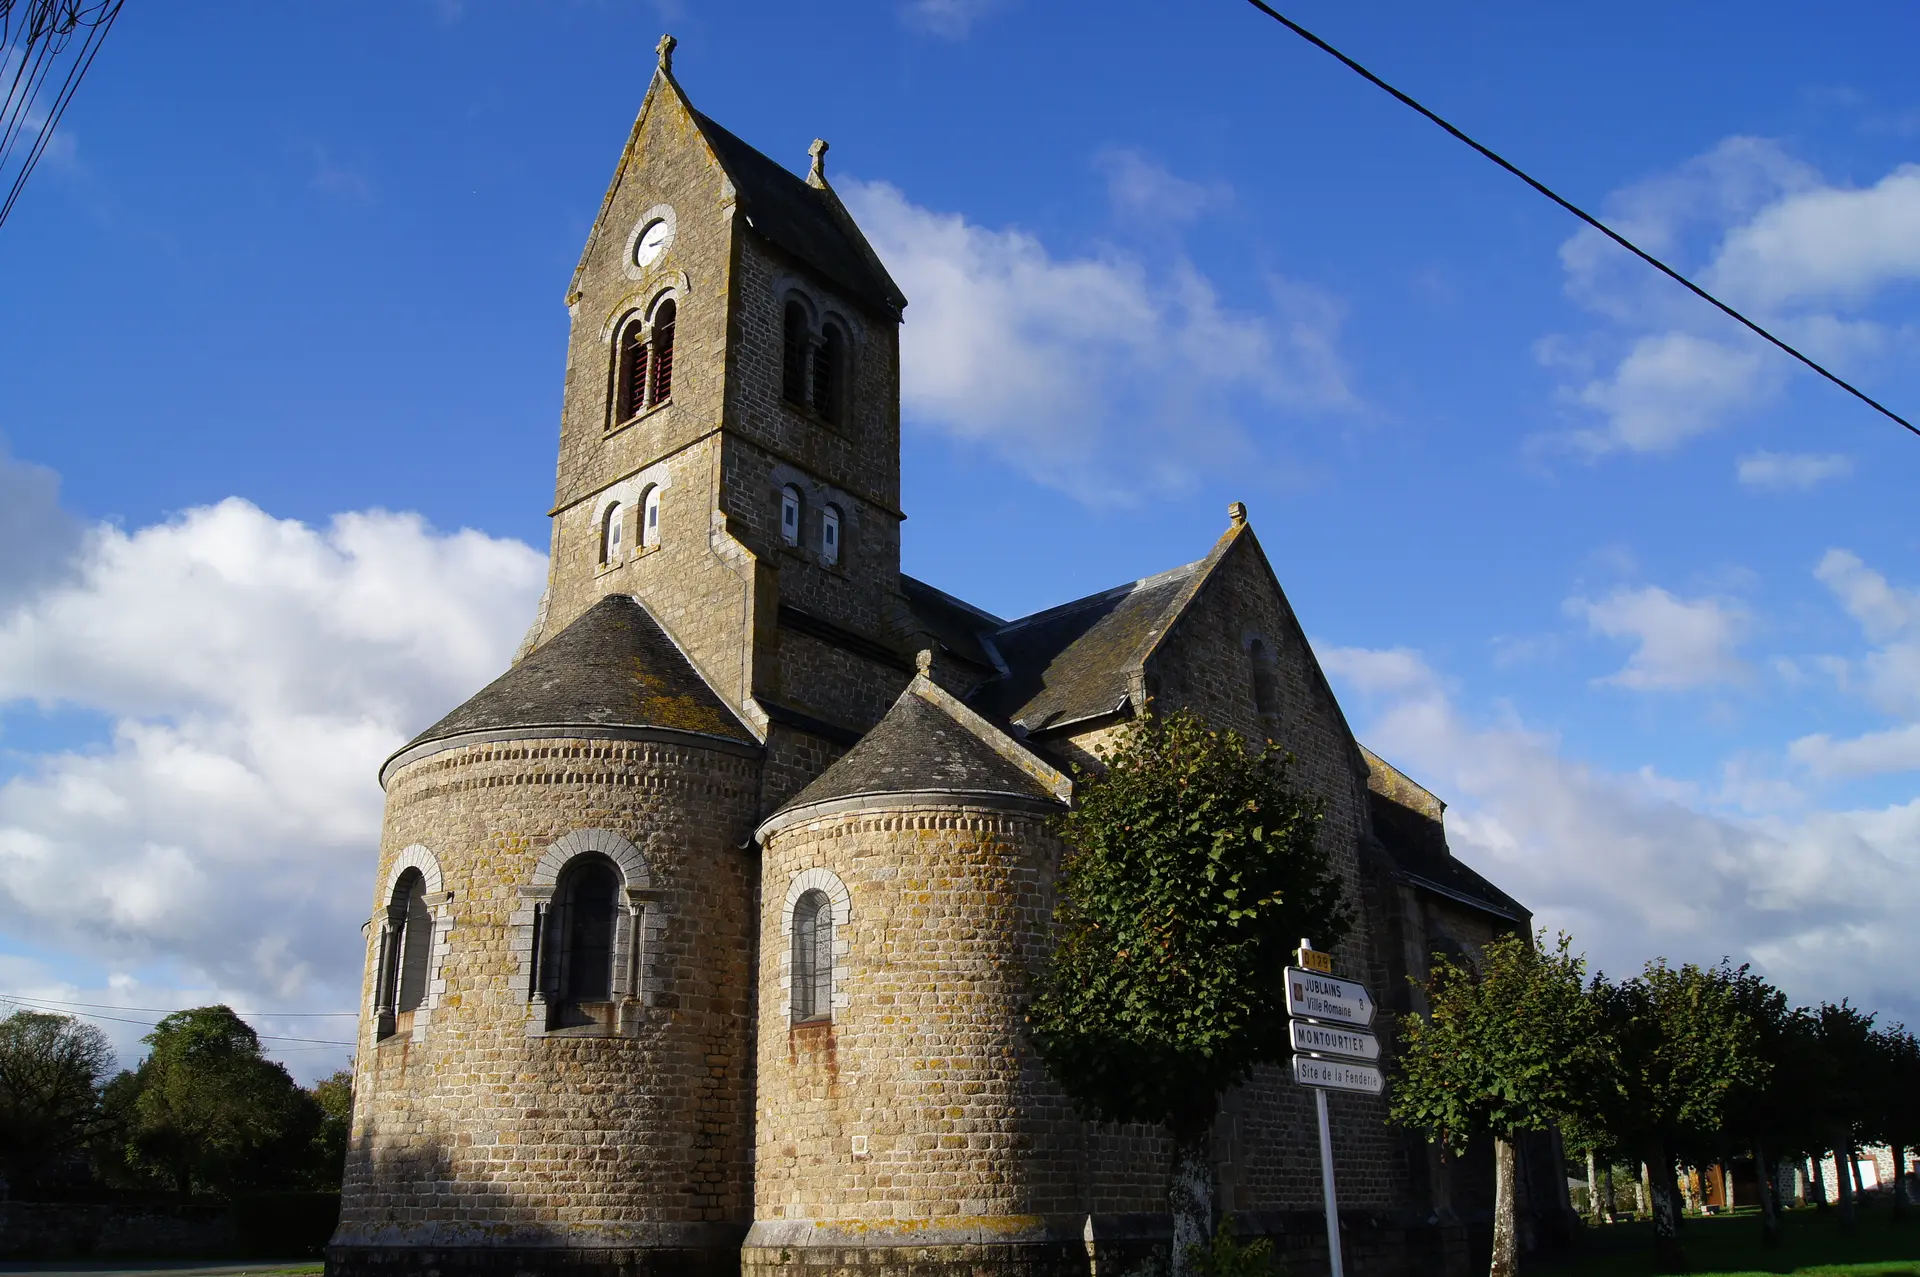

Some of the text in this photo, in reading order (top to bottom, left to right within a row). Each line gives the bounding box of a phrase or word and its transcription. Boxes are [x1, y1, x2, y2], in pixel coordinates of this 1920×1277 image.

[1312, 953, 1329, 969] 129
[1304, 979, 1342, 998] JUBLAINS
[1306, 997, 1352, 1017] Ville Romaine
[1297, 1028, 1364, 1052] MONTOURTIER
[1301, 1063, 1377, 1086] Site de la Fenderie
